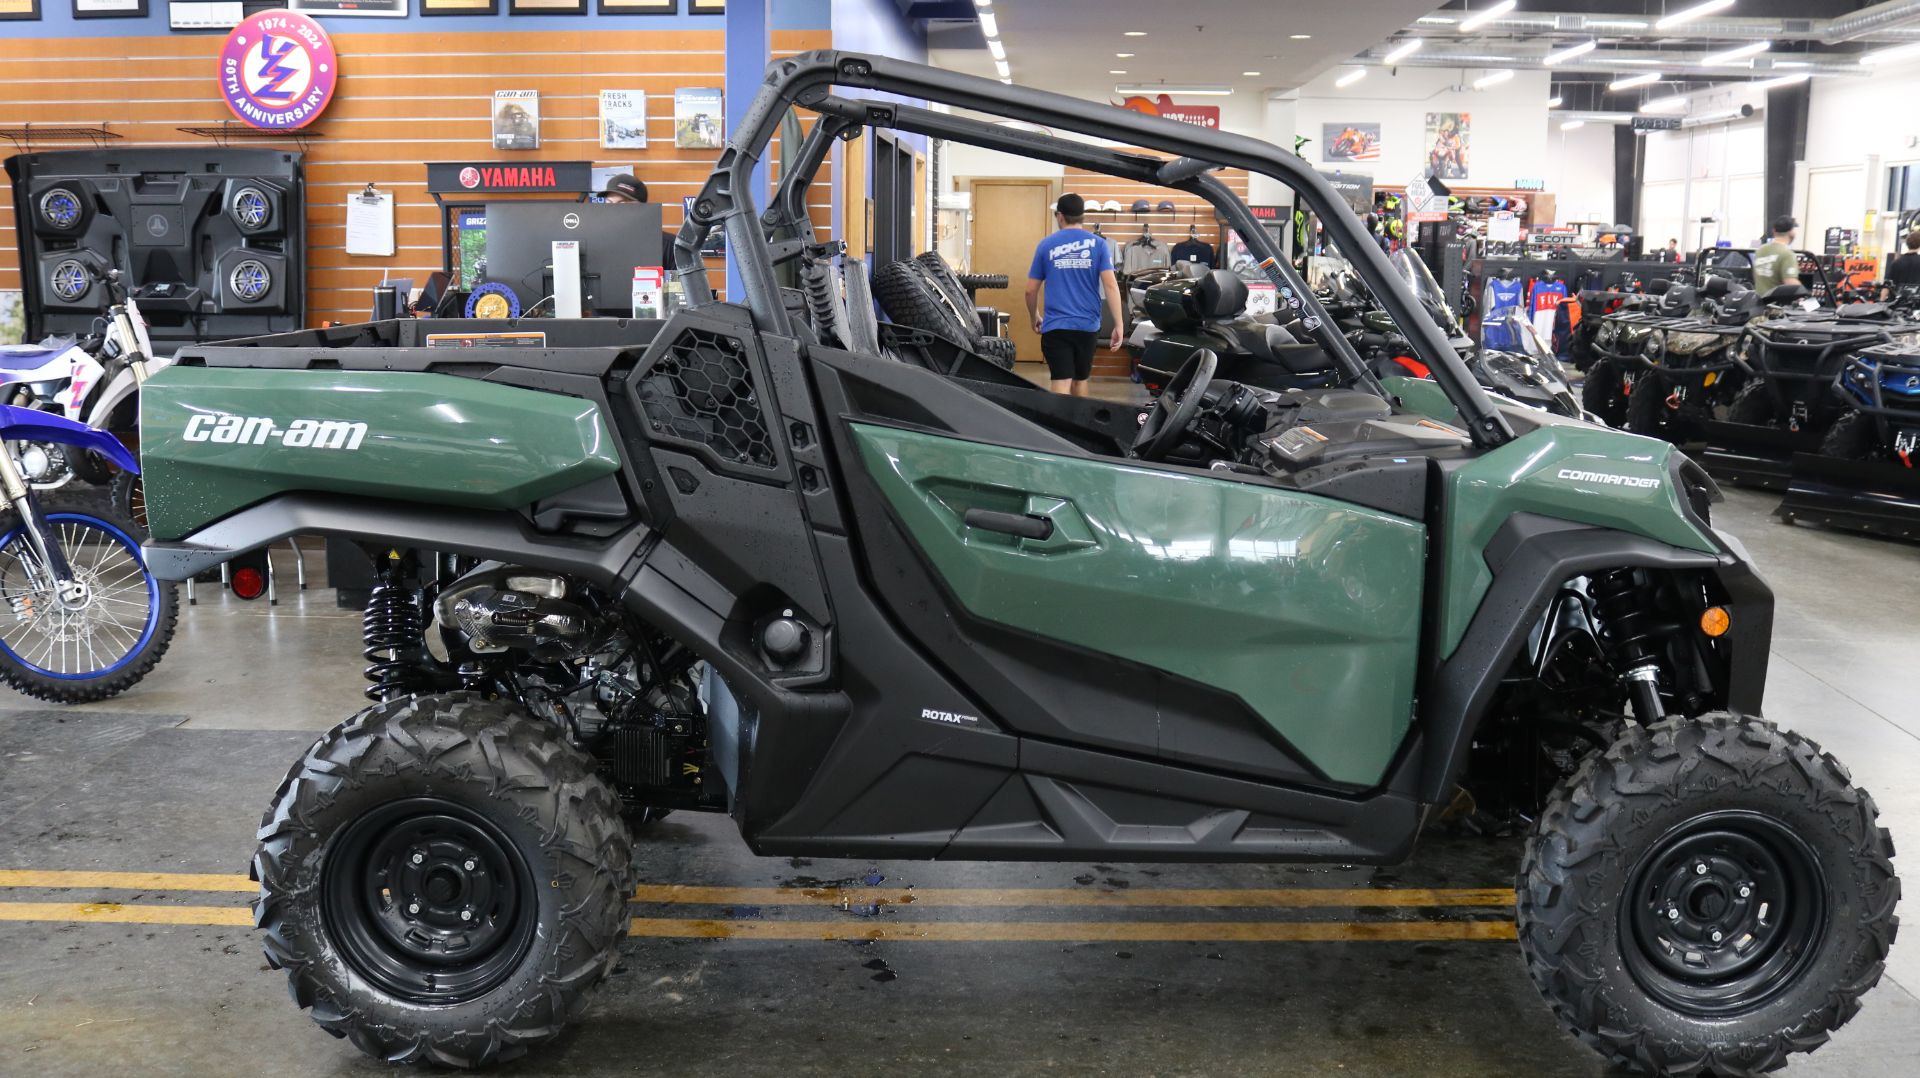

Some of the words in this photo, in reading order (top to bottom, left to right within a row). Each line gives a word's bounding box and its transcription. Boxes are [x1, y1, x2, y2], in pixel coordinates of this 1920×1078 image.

[258, 18, 286, 31] 1974
[297, 24, 322, 49] 2024
[226, 58, 240, 94] 50TH
[235, 86, 324, 124] ANNIVERSARY
[481, 168, 556, 187] YAMAHA
[466, 217, 486, 225] GRIZZ
[1250, 208, 1276, 218] MAHA
[1535, 235, 1576, 243] SCOTT
[1049, 239, 1096, 260] HICKLIN
[1540, 295, 1559, 304] FLY
[1558, 469, 1660, 488] COMMANDER
[922, 709, 961, 723] ROTAX
